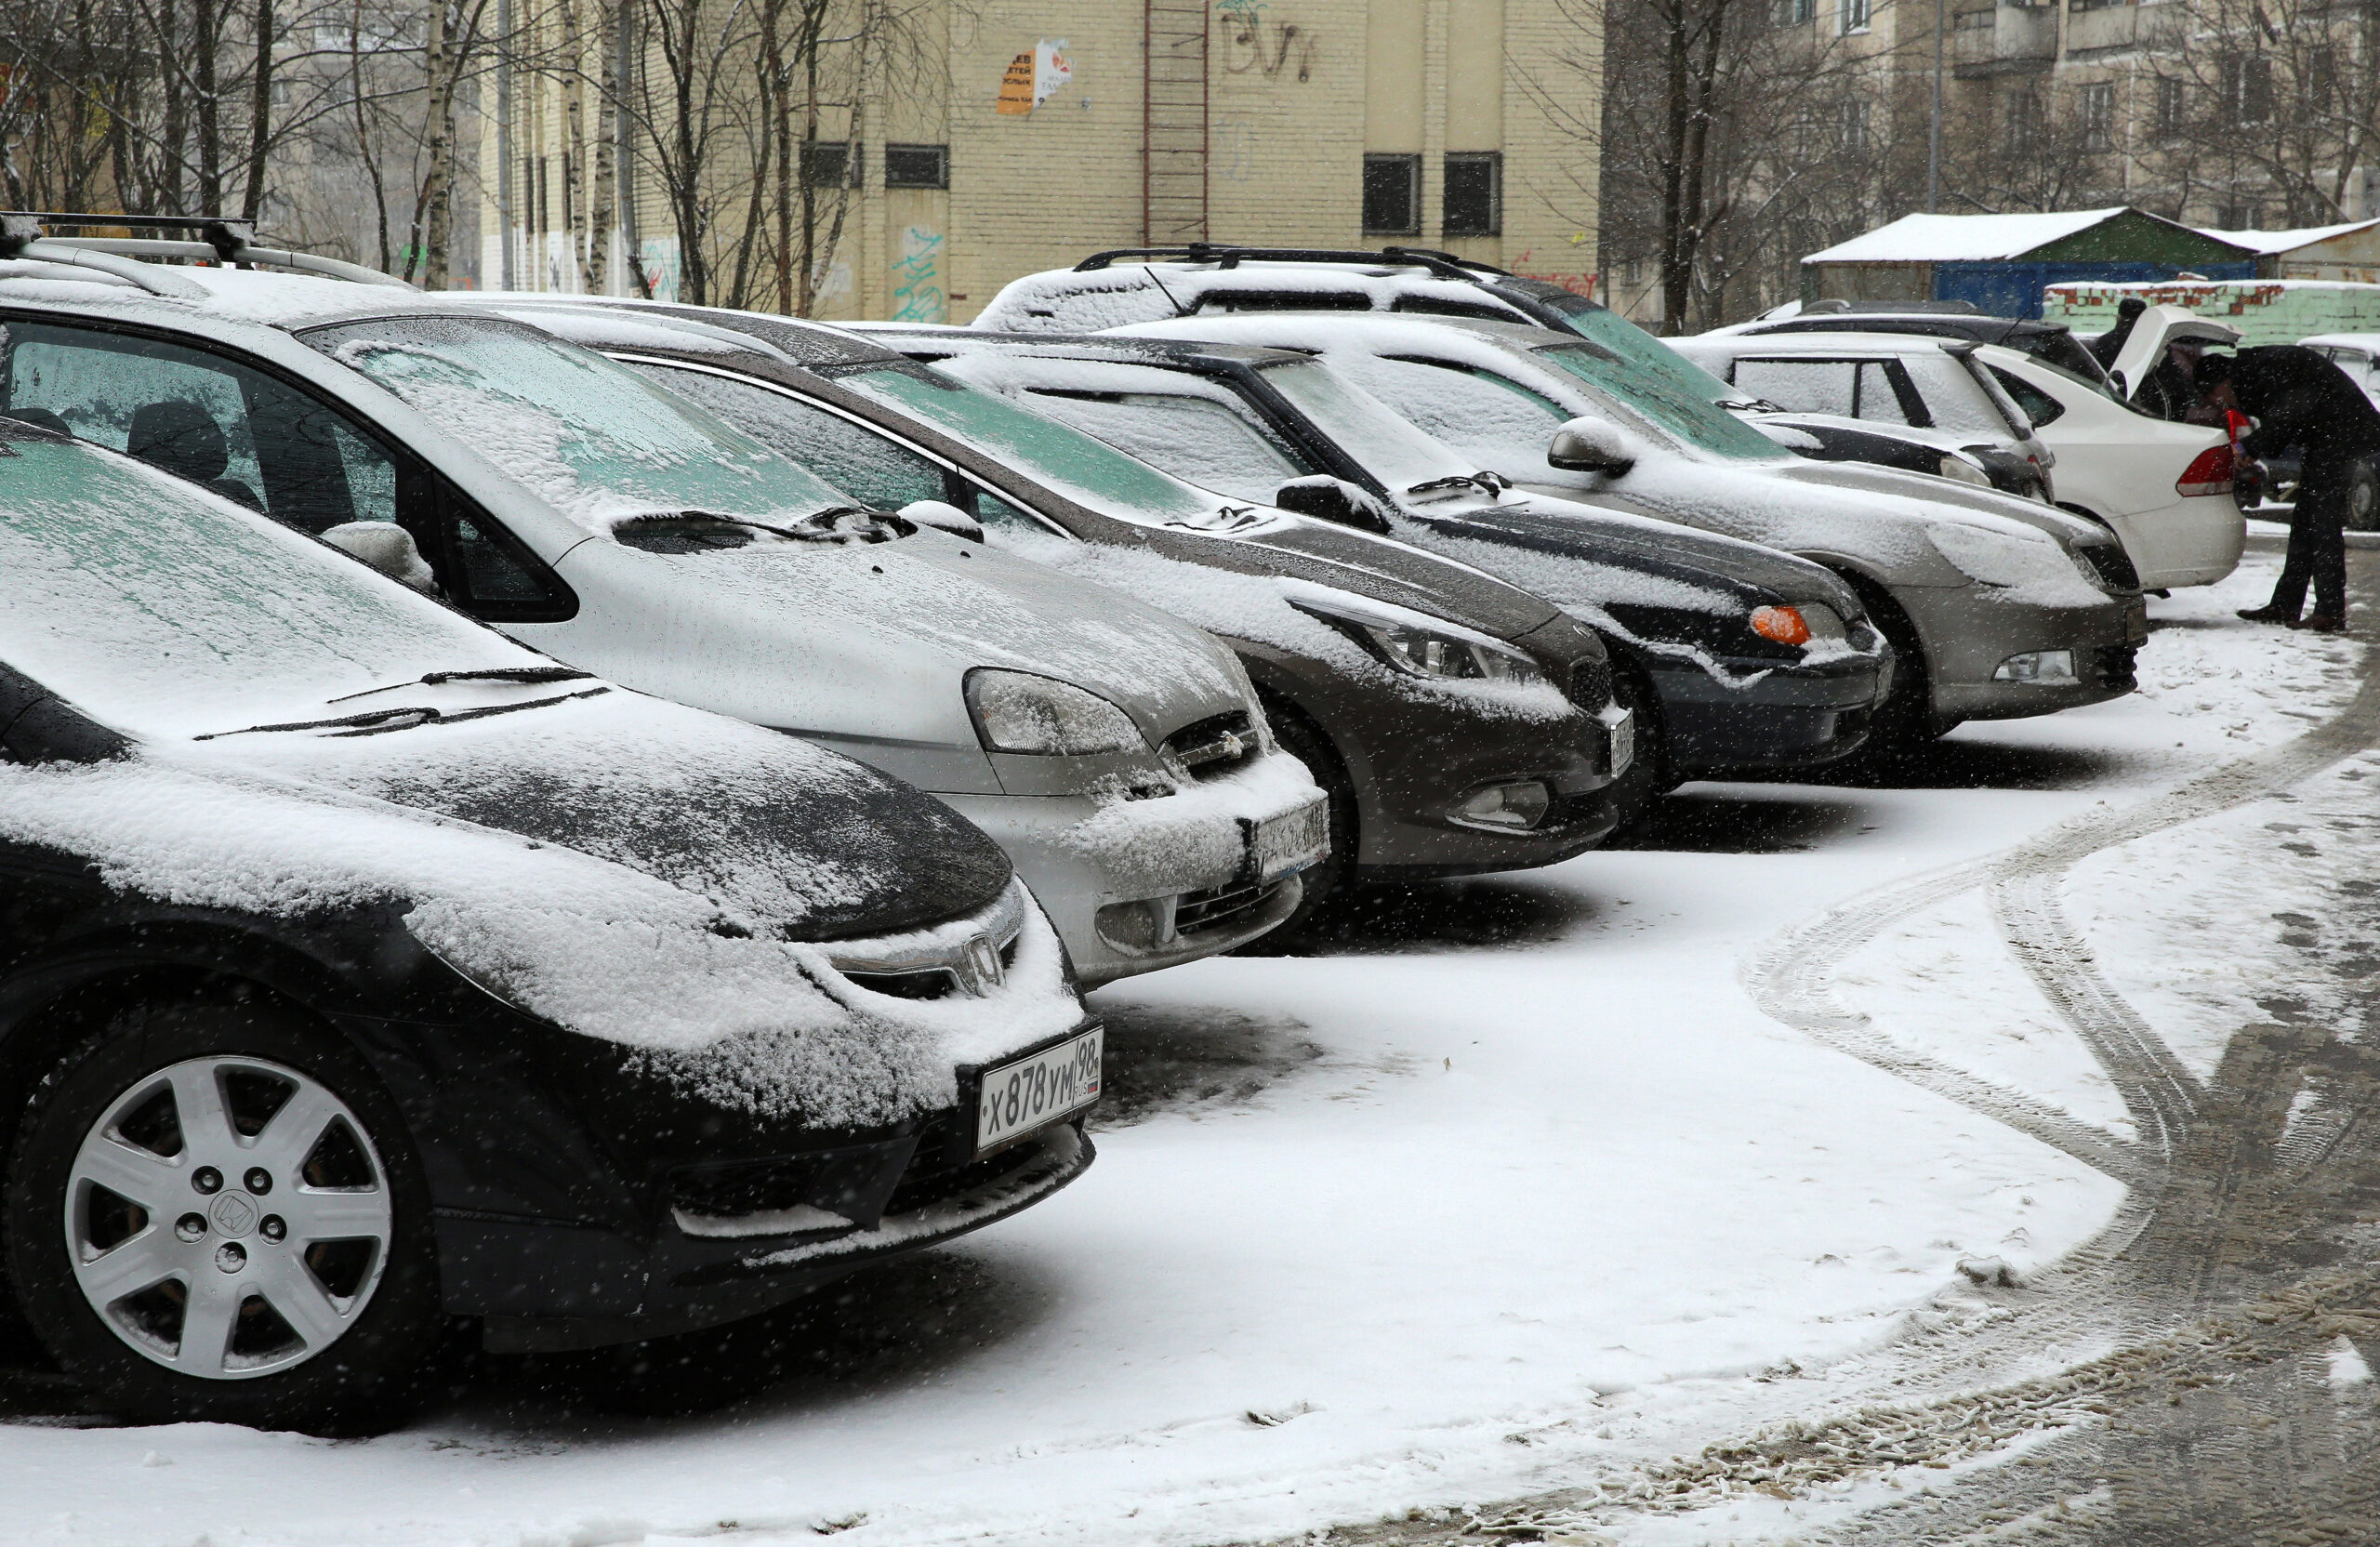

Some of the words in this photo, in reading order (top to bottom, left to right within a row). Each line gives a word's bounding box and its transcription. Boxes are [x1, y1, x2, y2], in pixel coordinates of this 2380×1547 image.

[1012, 54, 1031, 64] ЕВ
[1007, 66, 1031, 74] ЕТЕЙ
[988, 1060, 1075, 1135] Х878УМ
[1078, 1038, 1096, 1082] 98
[1074, 1081, 1088, 1099] RUS
